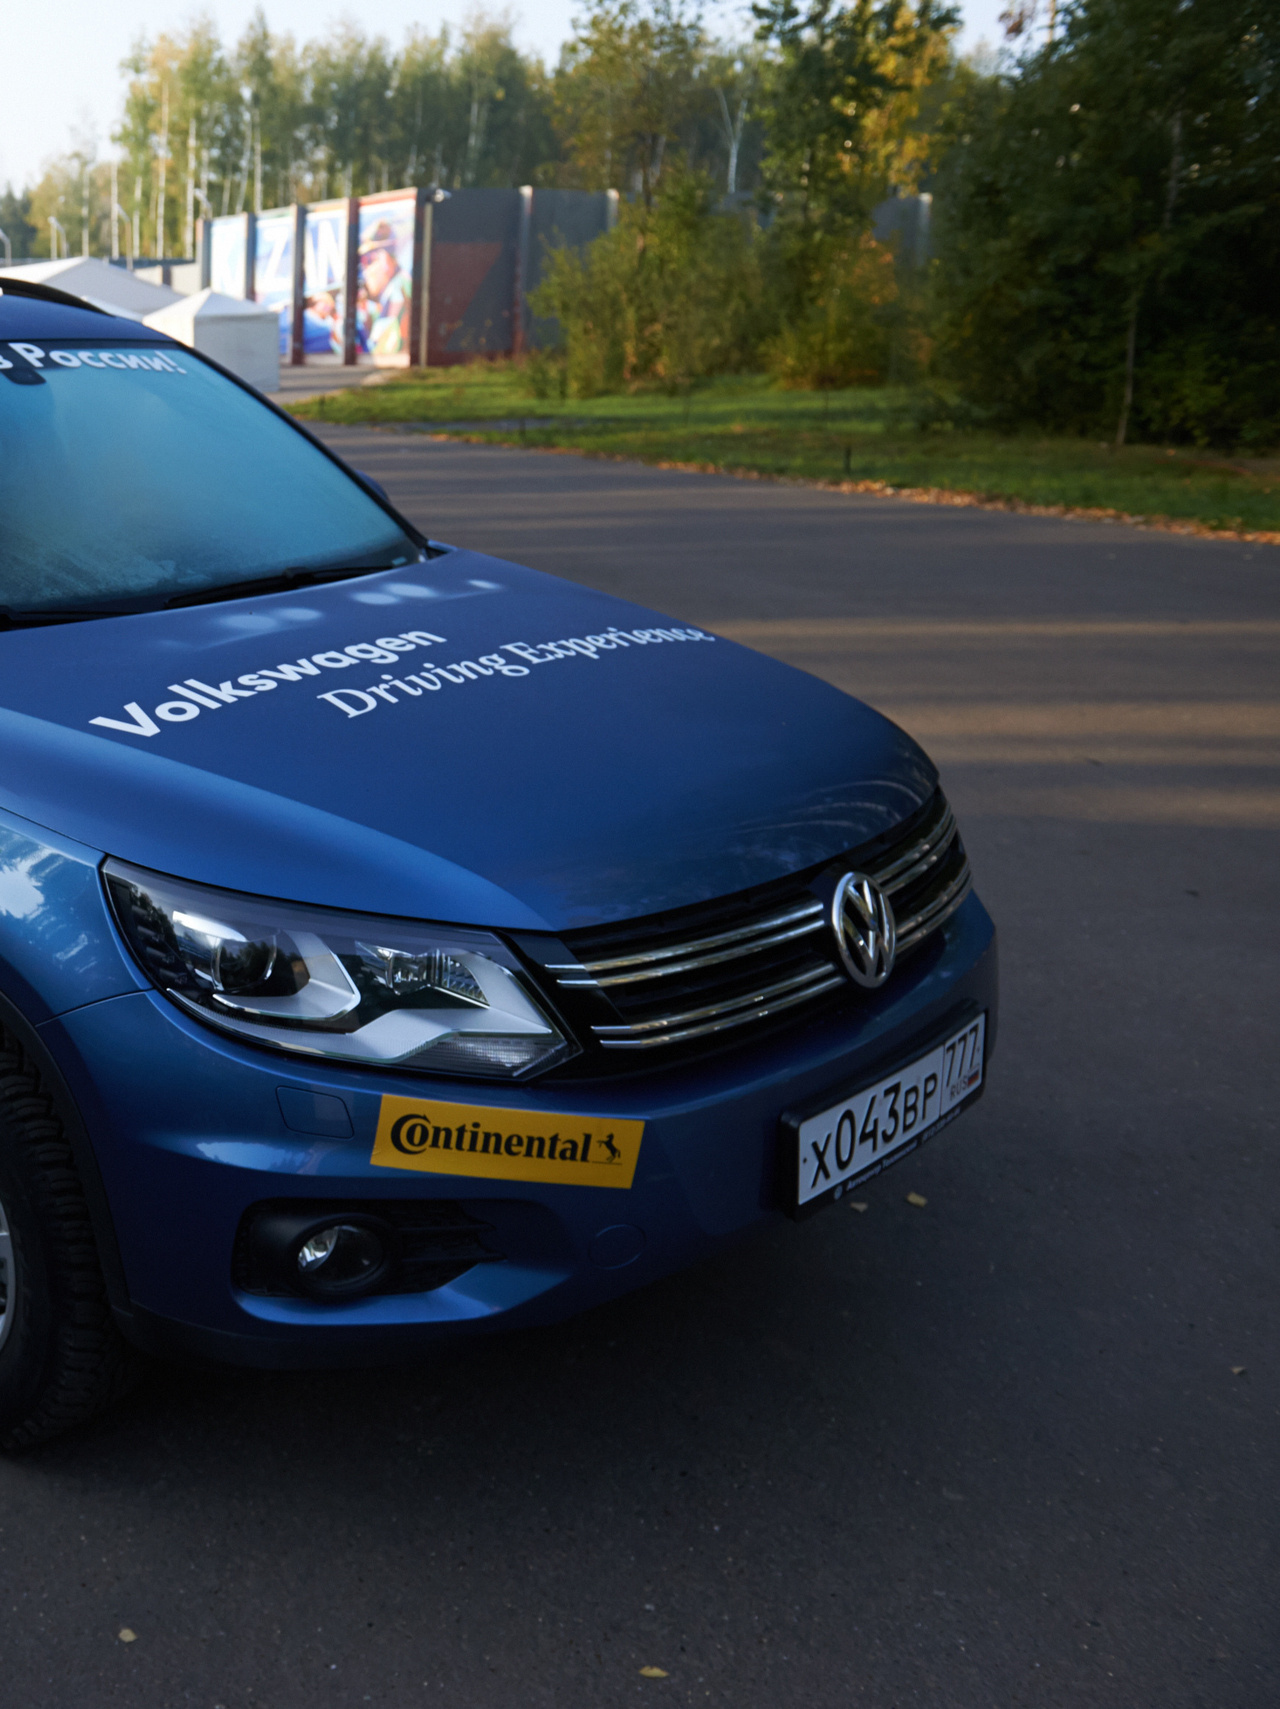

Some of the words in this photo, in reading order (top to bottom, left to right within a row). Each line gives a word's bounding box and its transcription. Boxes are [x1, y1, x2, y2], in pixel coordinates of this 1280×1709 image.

[8, 341, 188, 375] России!
[88, 629, 447, 738] Volkswagen
[317, 650, 531, 719] Driving
[500, 626, 716, 664] Experience
[945, 1023, 979, 1087] 777
[949, 1075, 969, 1101] RUS
[390, 1113, 592, 1163] Continental
